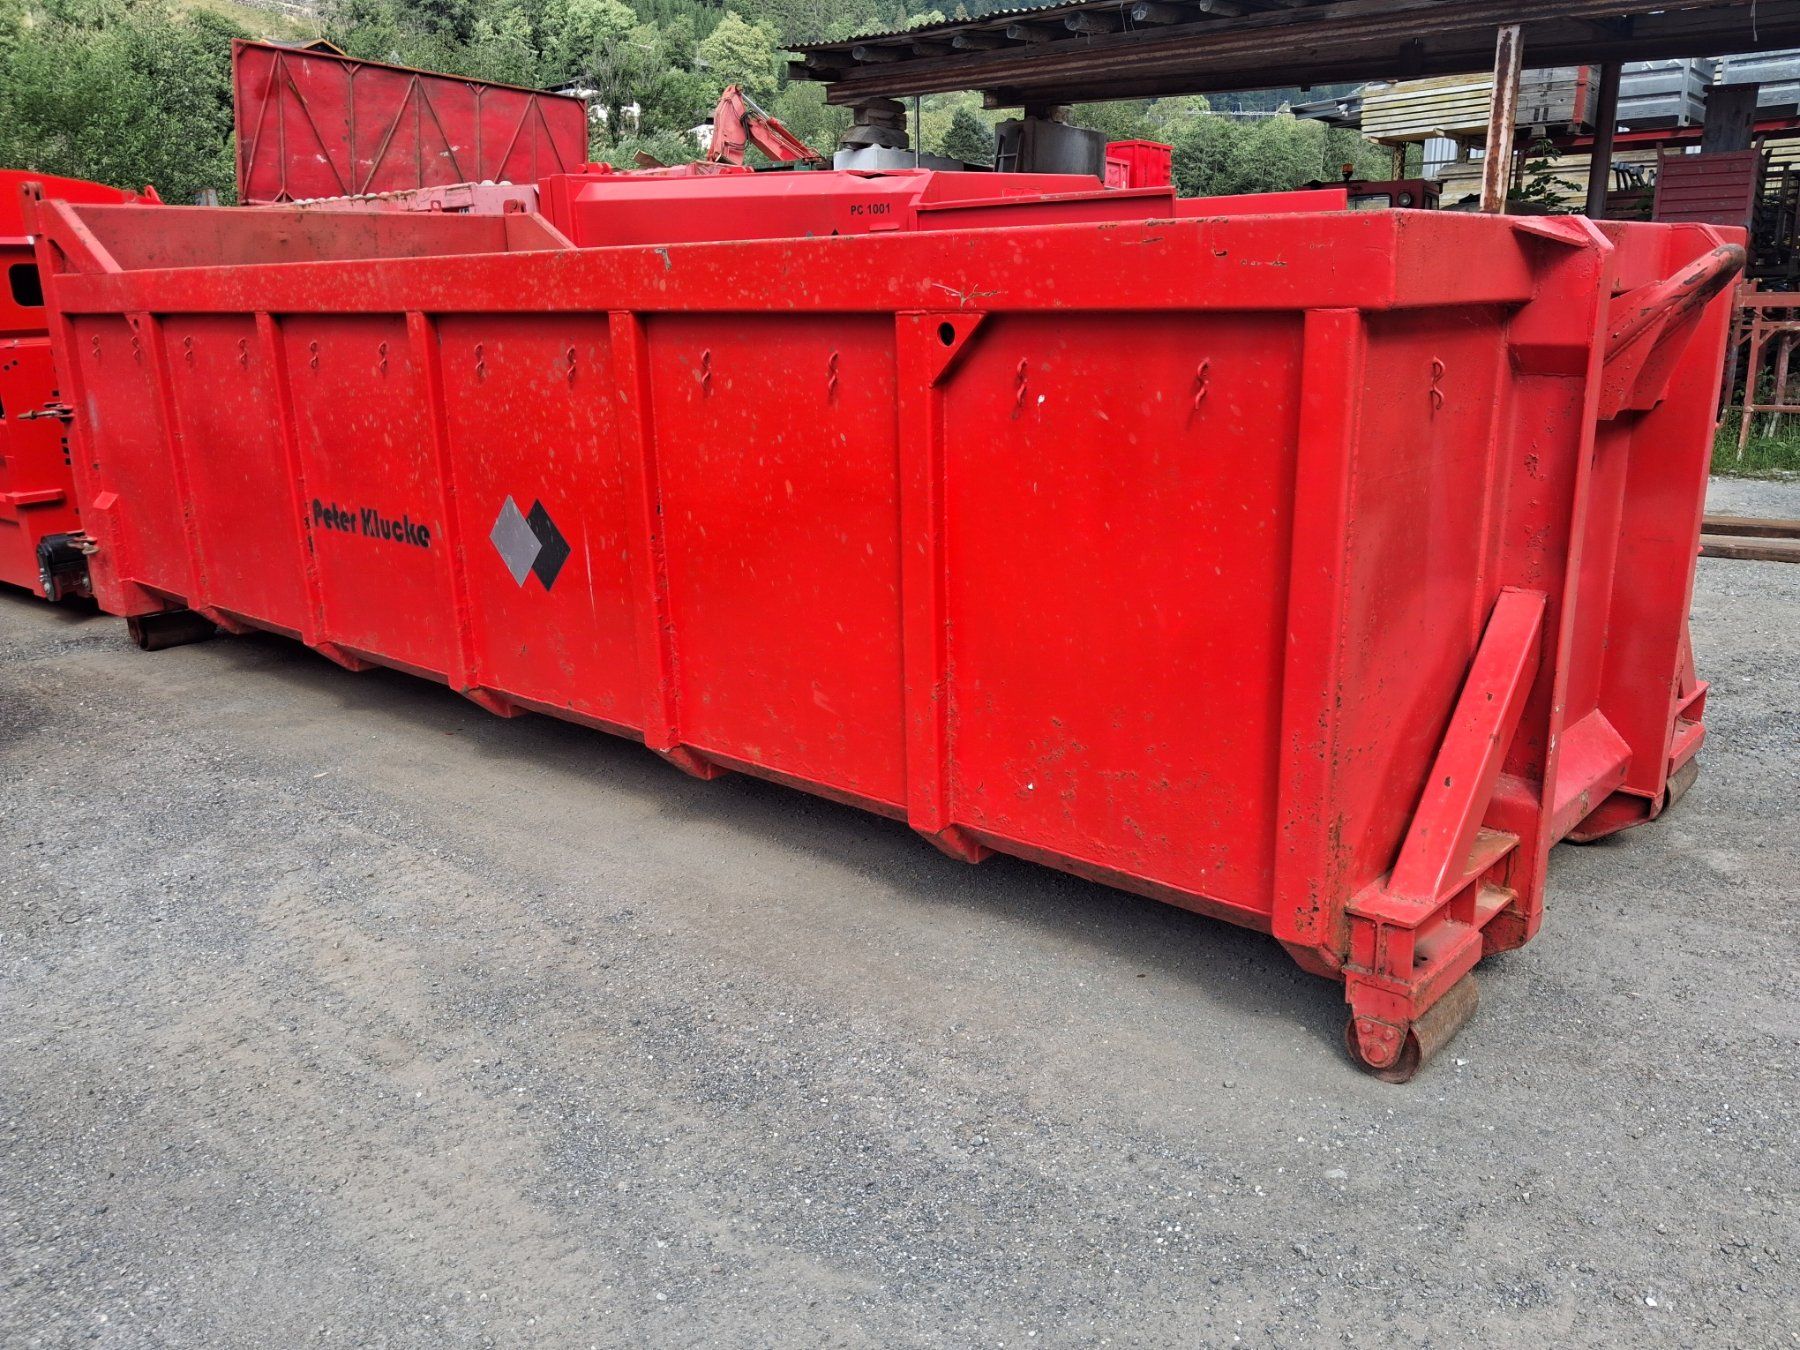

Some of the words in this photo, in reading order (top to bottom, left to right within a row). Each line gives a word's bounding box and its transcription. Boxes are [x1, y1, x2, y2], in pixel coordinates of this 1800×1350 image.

[850, 204, 864, 216] PC
[867, 202, 891, 215] 1001
[312, 498, 357, 533] Peter
[360, 507, 431, 548] Klucke
